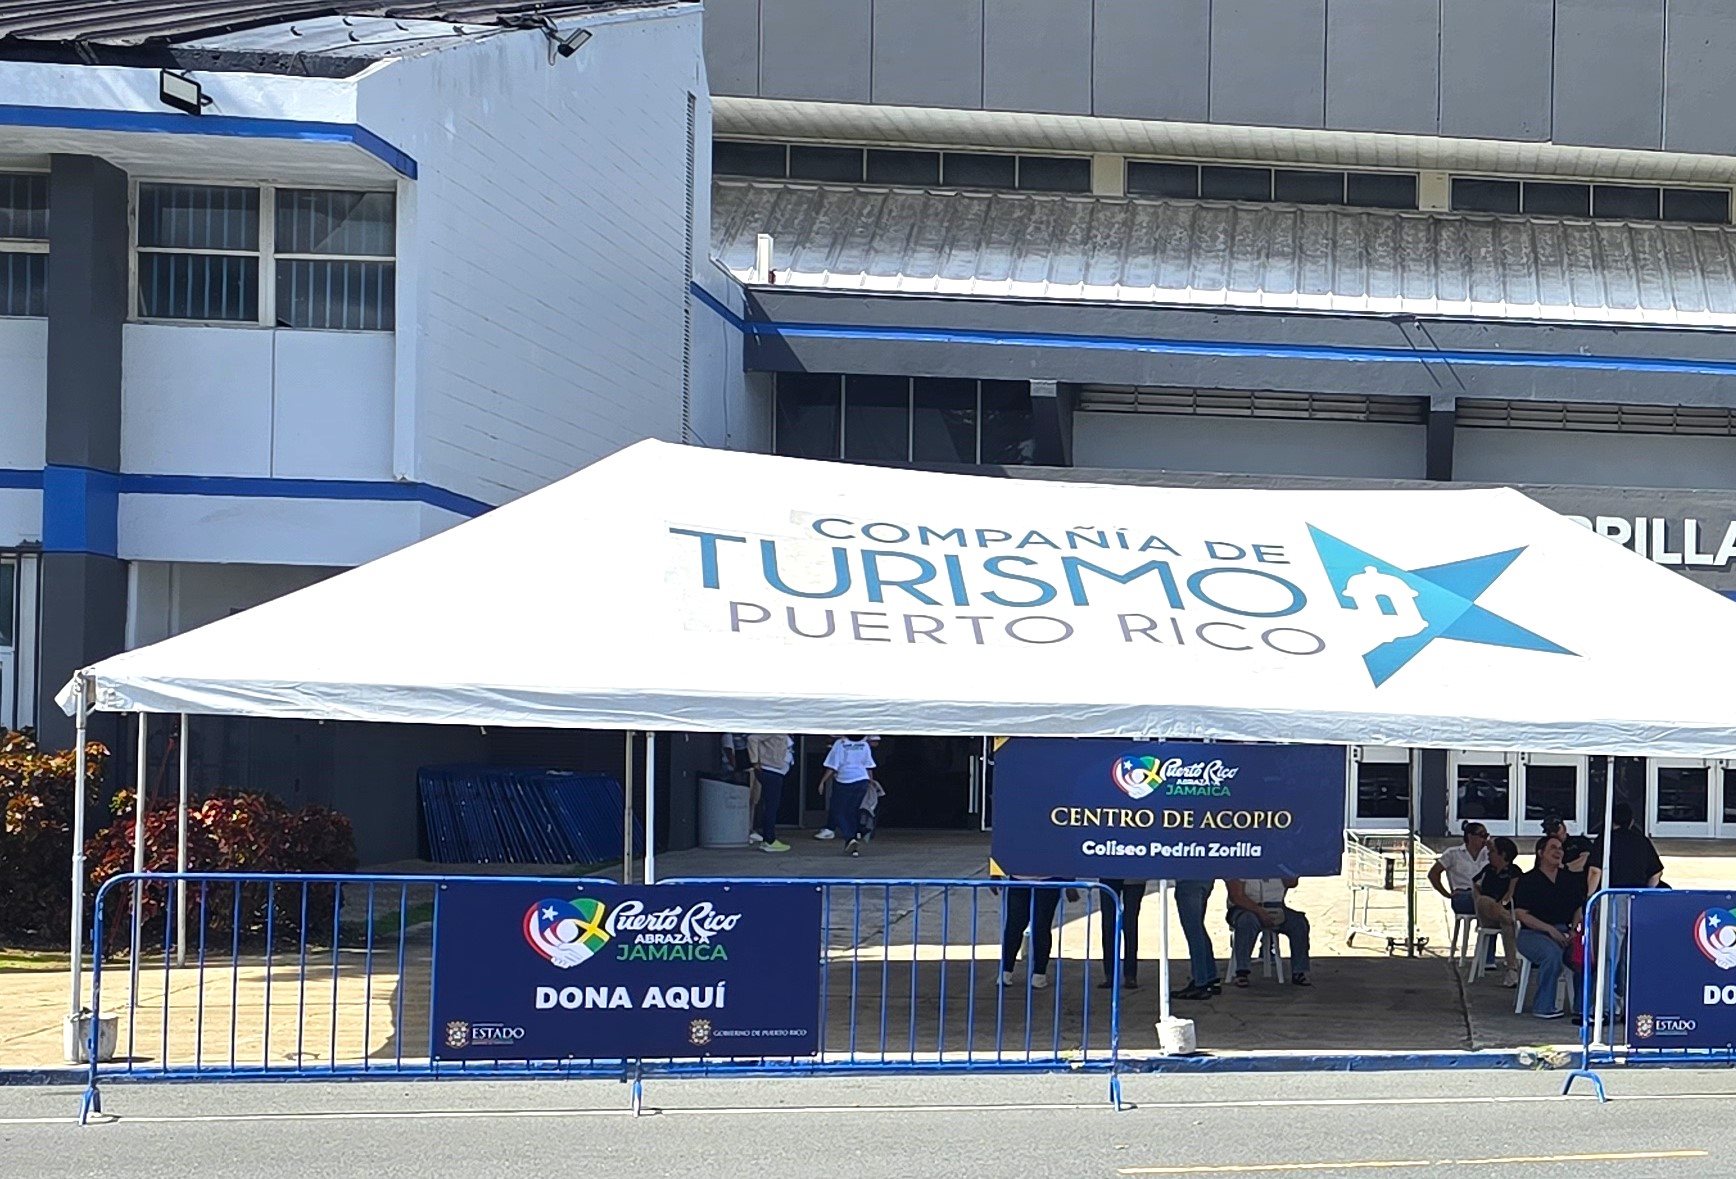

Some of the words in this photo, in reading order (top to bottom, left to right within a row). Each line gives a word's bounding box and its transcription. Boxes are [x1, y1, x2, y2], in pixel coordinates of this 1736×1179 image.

[811, 516, 1183, 556] COMPAÑÍA
[1205, 540, 1292, 566] DE
[668, 526, 1309, 619] TURISMO
[729, 600, 1075, 646] PUERTO
[1119, 612, 1327, 656] RICO
[1159, 758, 1206, 781] Puerto
[1203, 759, 1239, 782] Rico
[1165, 784, 1231, 797] JAMAICA
[1050, 807, 1154, 828] CENTRO
[1162, 810, 1194, 829] DE
[1200, 810, 1292, 830] ACOPIO
[1082, 840, 1147, 857] Coliseo
[1150, 841, 1206, 858] Pedrín
[1207, 842, 1262, 858] Zorilla
[605, 900, 683, 938] Puerto
[680, 901, 742, 937] Rico
[634, 933, 693, 944] ABRAZA
[616, 944, 728, 961] JAMAICA
[535, 986, 633, 1010] DONA
[641, 980, 727, 1010] AQUÍ
[472, 1027, 525, 1039] ESTADO
[1655, 1019, 1696, 1031] ESTADO
